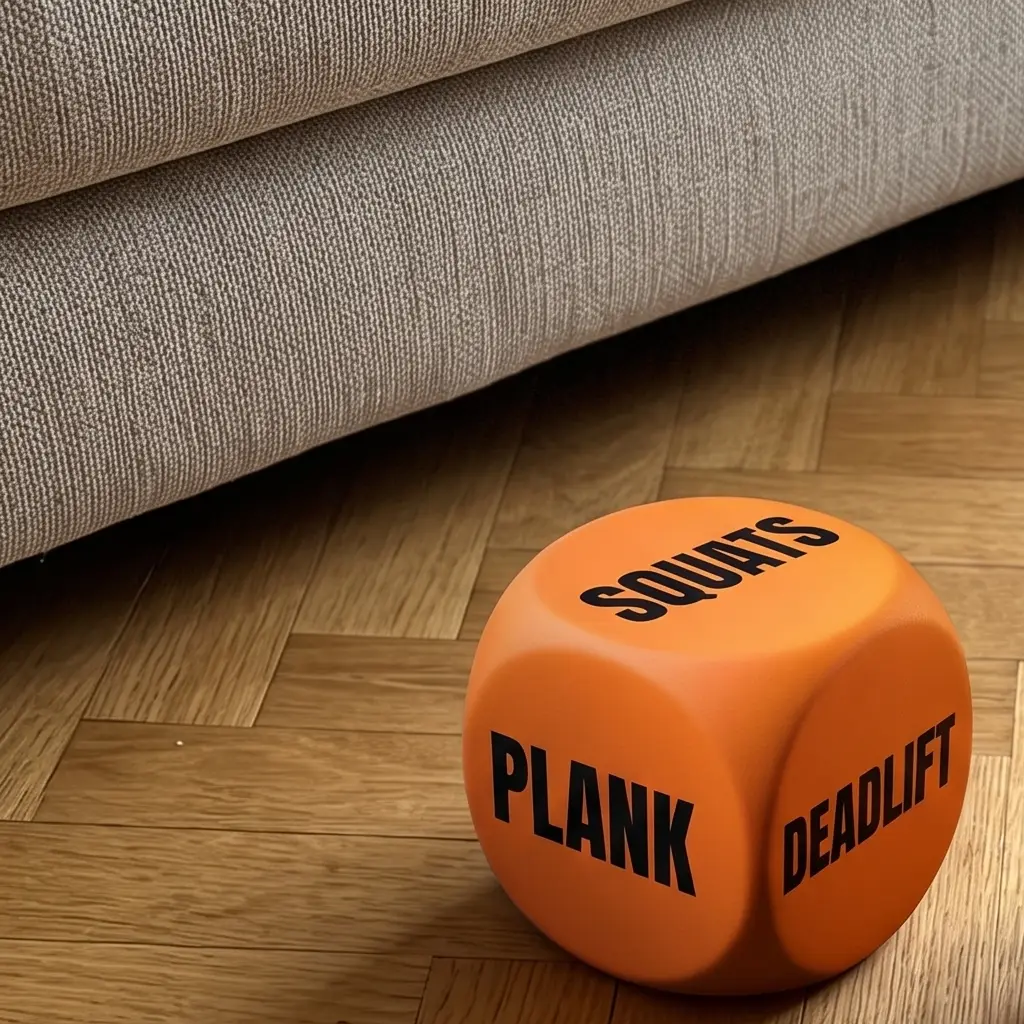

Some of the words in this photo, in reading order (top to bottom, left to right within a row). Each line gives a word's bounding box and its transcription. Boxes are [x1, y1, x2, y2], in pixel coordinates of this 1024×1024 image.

[580, 517, 840, 622] SQUATS
[490, 730, 696, 897] PLANK
[783, 712, 956, 896] DEADLIFT
